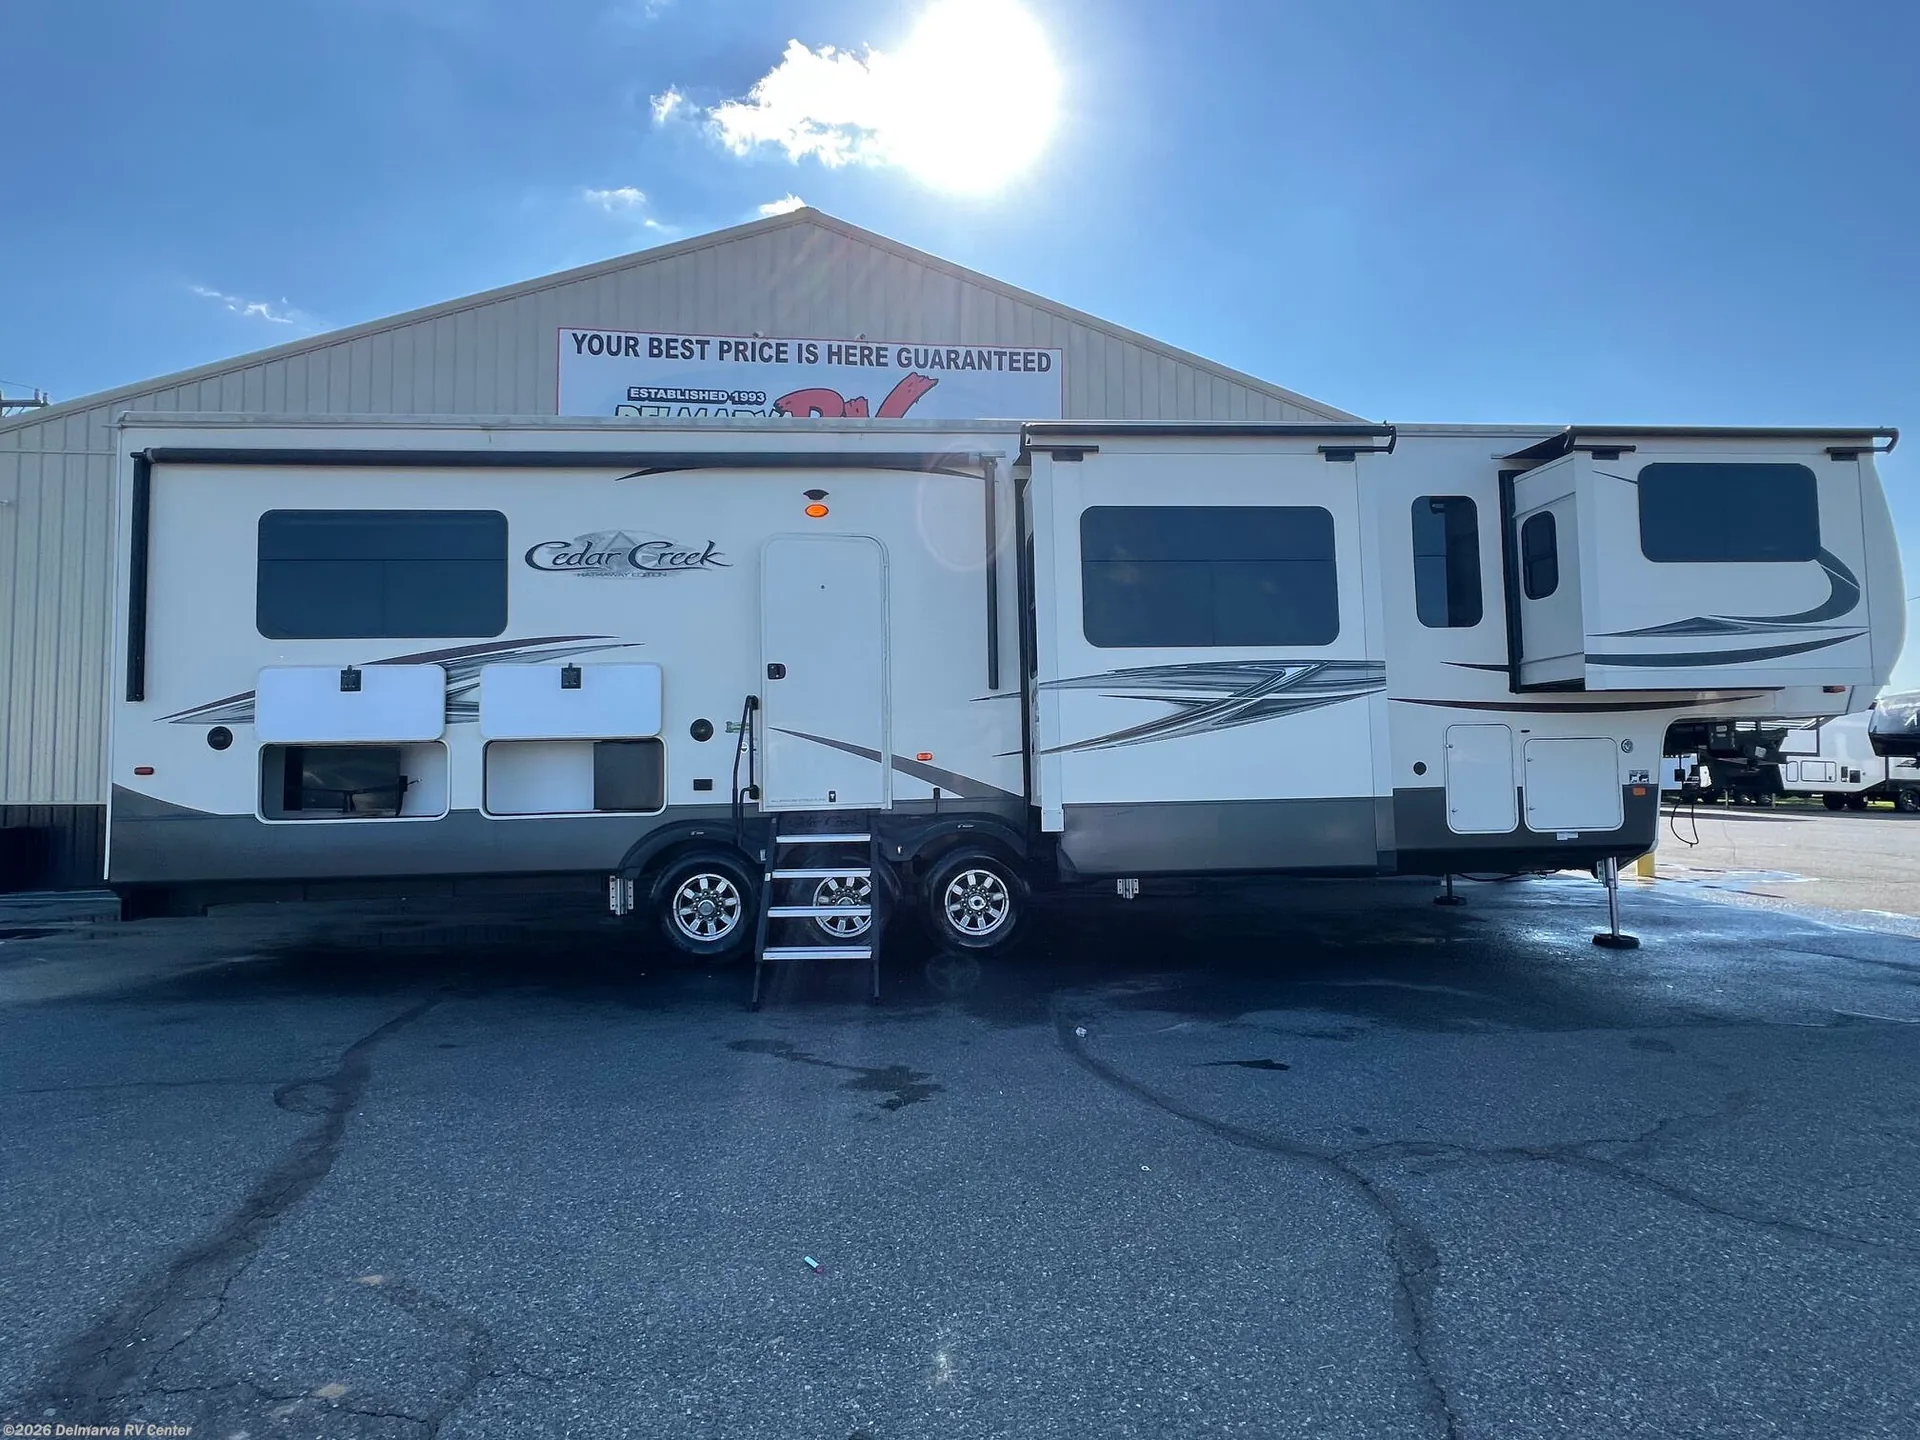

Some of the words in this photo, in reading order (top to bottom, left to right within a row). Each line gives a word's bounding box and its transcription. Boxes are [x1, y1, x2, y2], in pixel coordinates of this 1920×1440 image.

[572, 332, 640, 358] YOUR
[648, 336, 710, 361] BEST
[718, 339, 789, 364] PRICE
[797, 342, 819, 365] IS
[827, 343, 889, 368] HERE
[896, 347, 1053, 372] GUARANTEED
[629, 387, 729, 402] ESTABLISHED
[729, 391, 766, 404] 1993
[524, 540, 622, 571] Cedar
[627, 540, 733, 571] Creek
